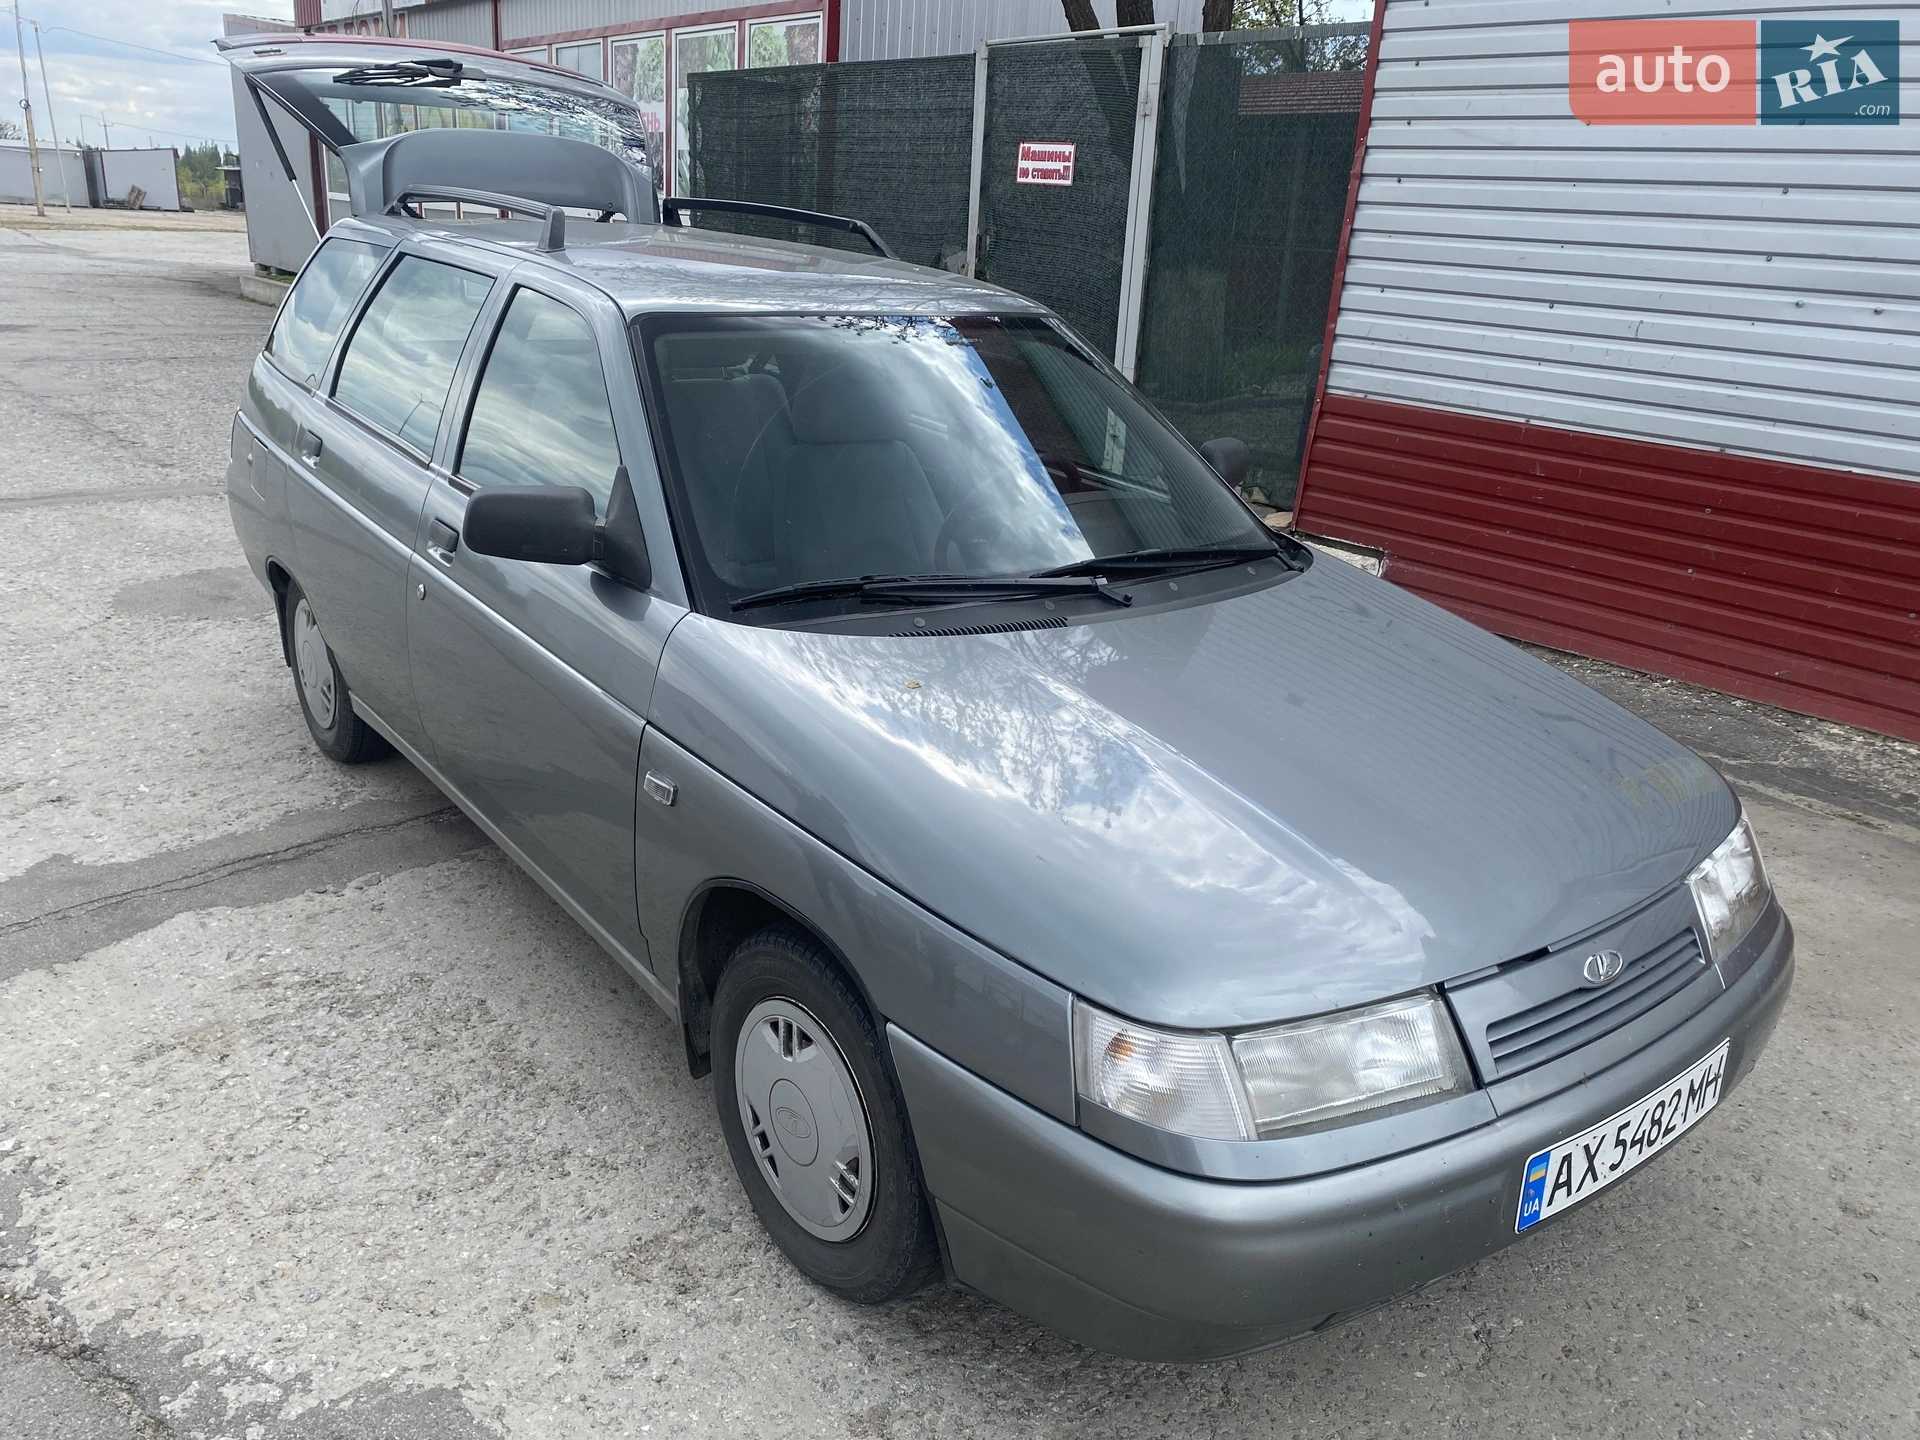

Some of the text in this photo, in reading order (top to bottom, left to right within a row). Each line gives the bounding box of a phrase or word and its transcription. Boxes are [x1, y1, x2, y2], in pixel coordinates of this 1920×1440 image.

[1020, 146, 1072, 163] Машины
[1547, 1054, 1724, 1207] AX 5482 MH
[1523, 1197, 1540, 1217] UA
